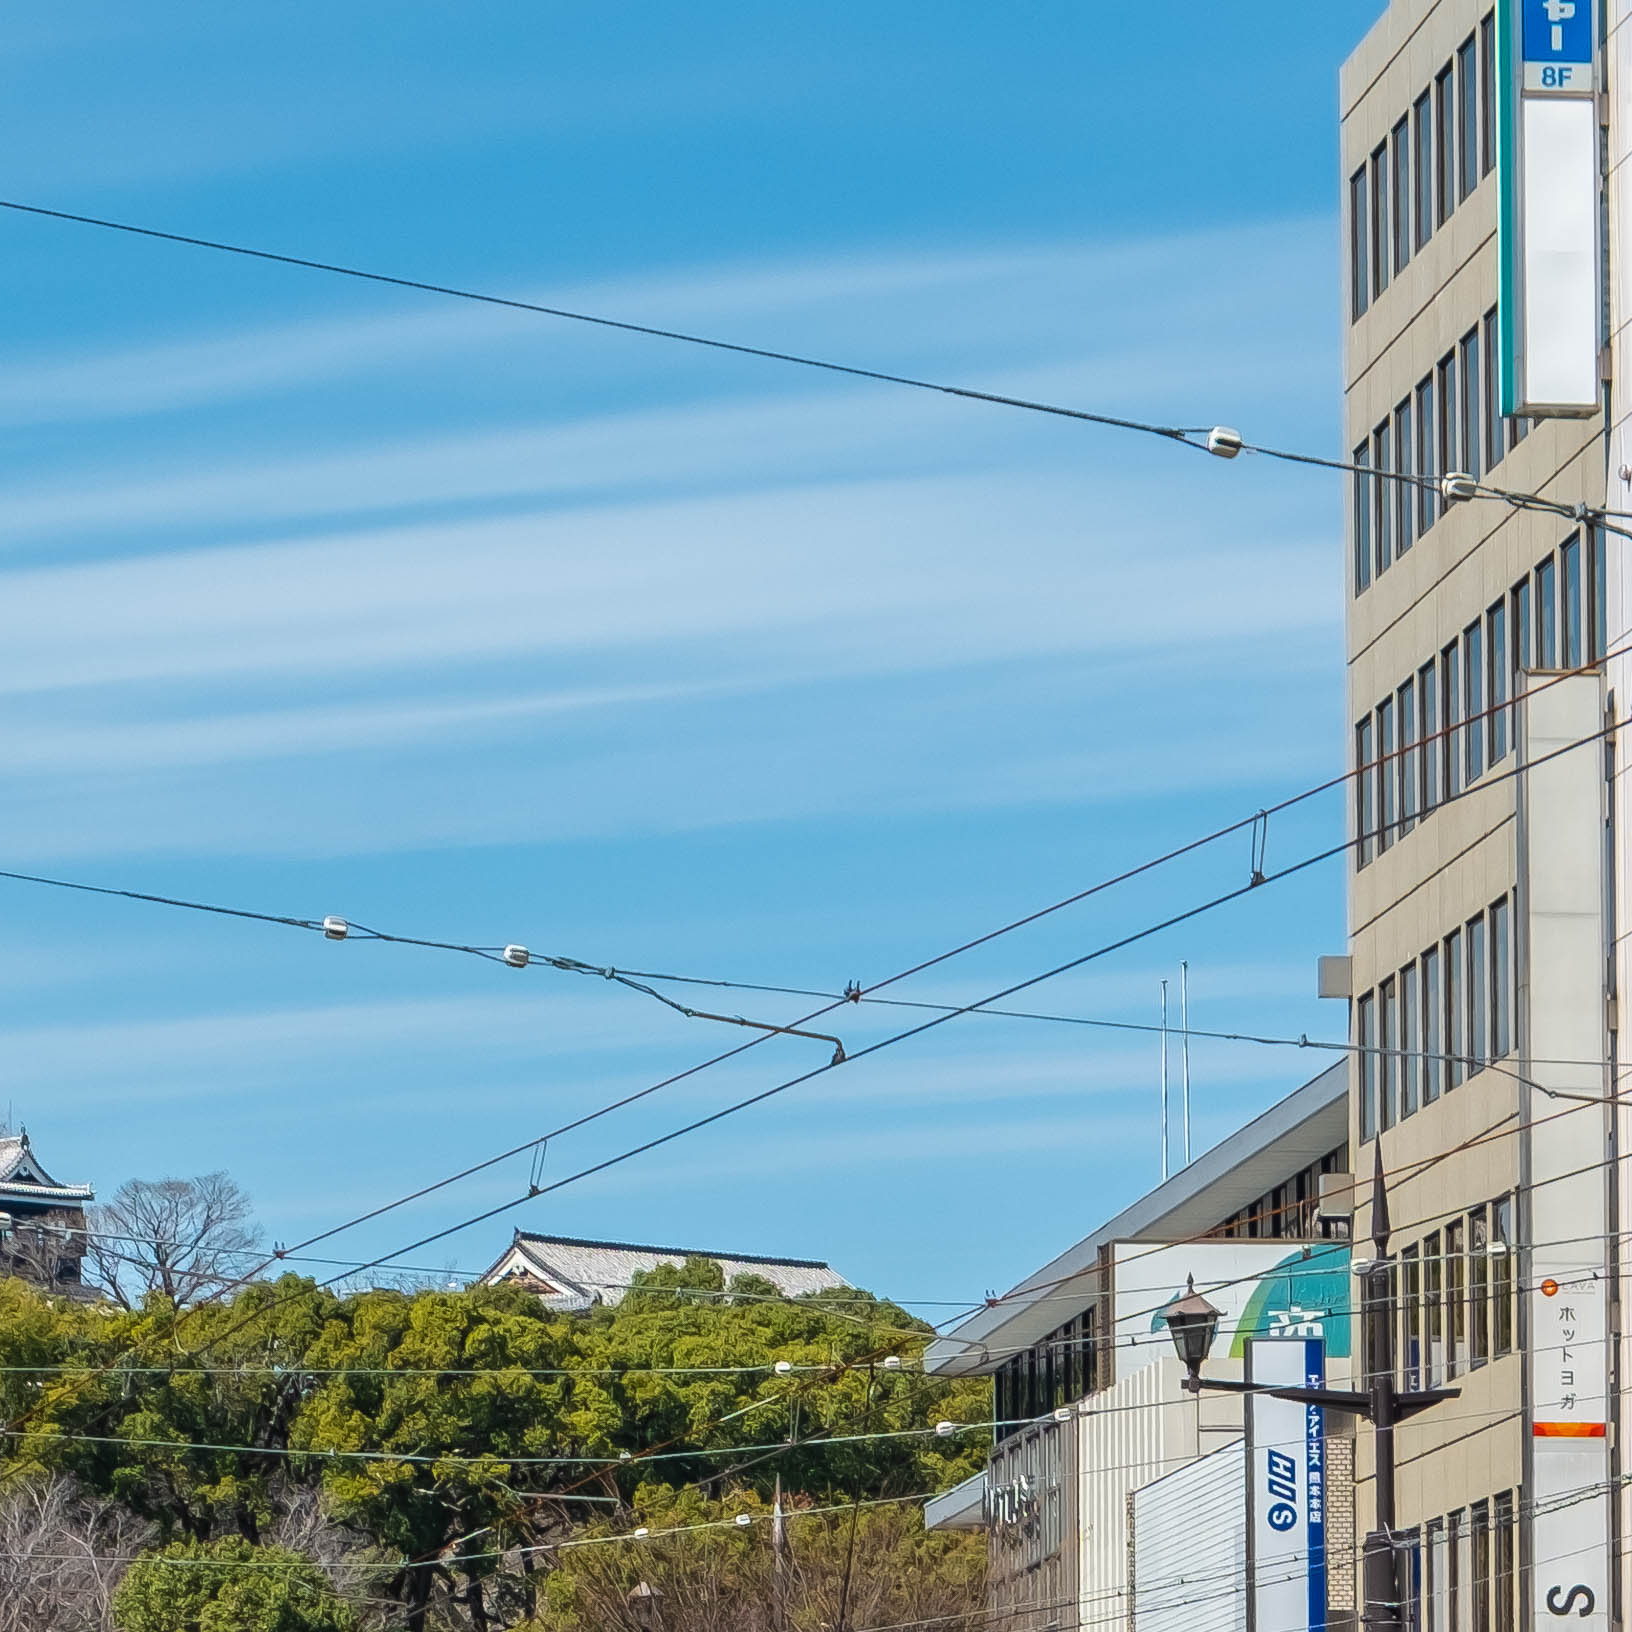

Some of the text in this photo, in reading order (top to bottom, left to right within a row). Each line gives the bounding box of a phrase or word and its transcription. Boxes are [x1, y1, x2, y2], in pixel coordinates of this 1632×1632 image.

[1541, 66, 1572, 87] 8F
[1558, 1306, 1577, 1411] ホットヨガ
[1269, 1451, 1296, 1529] HIS
